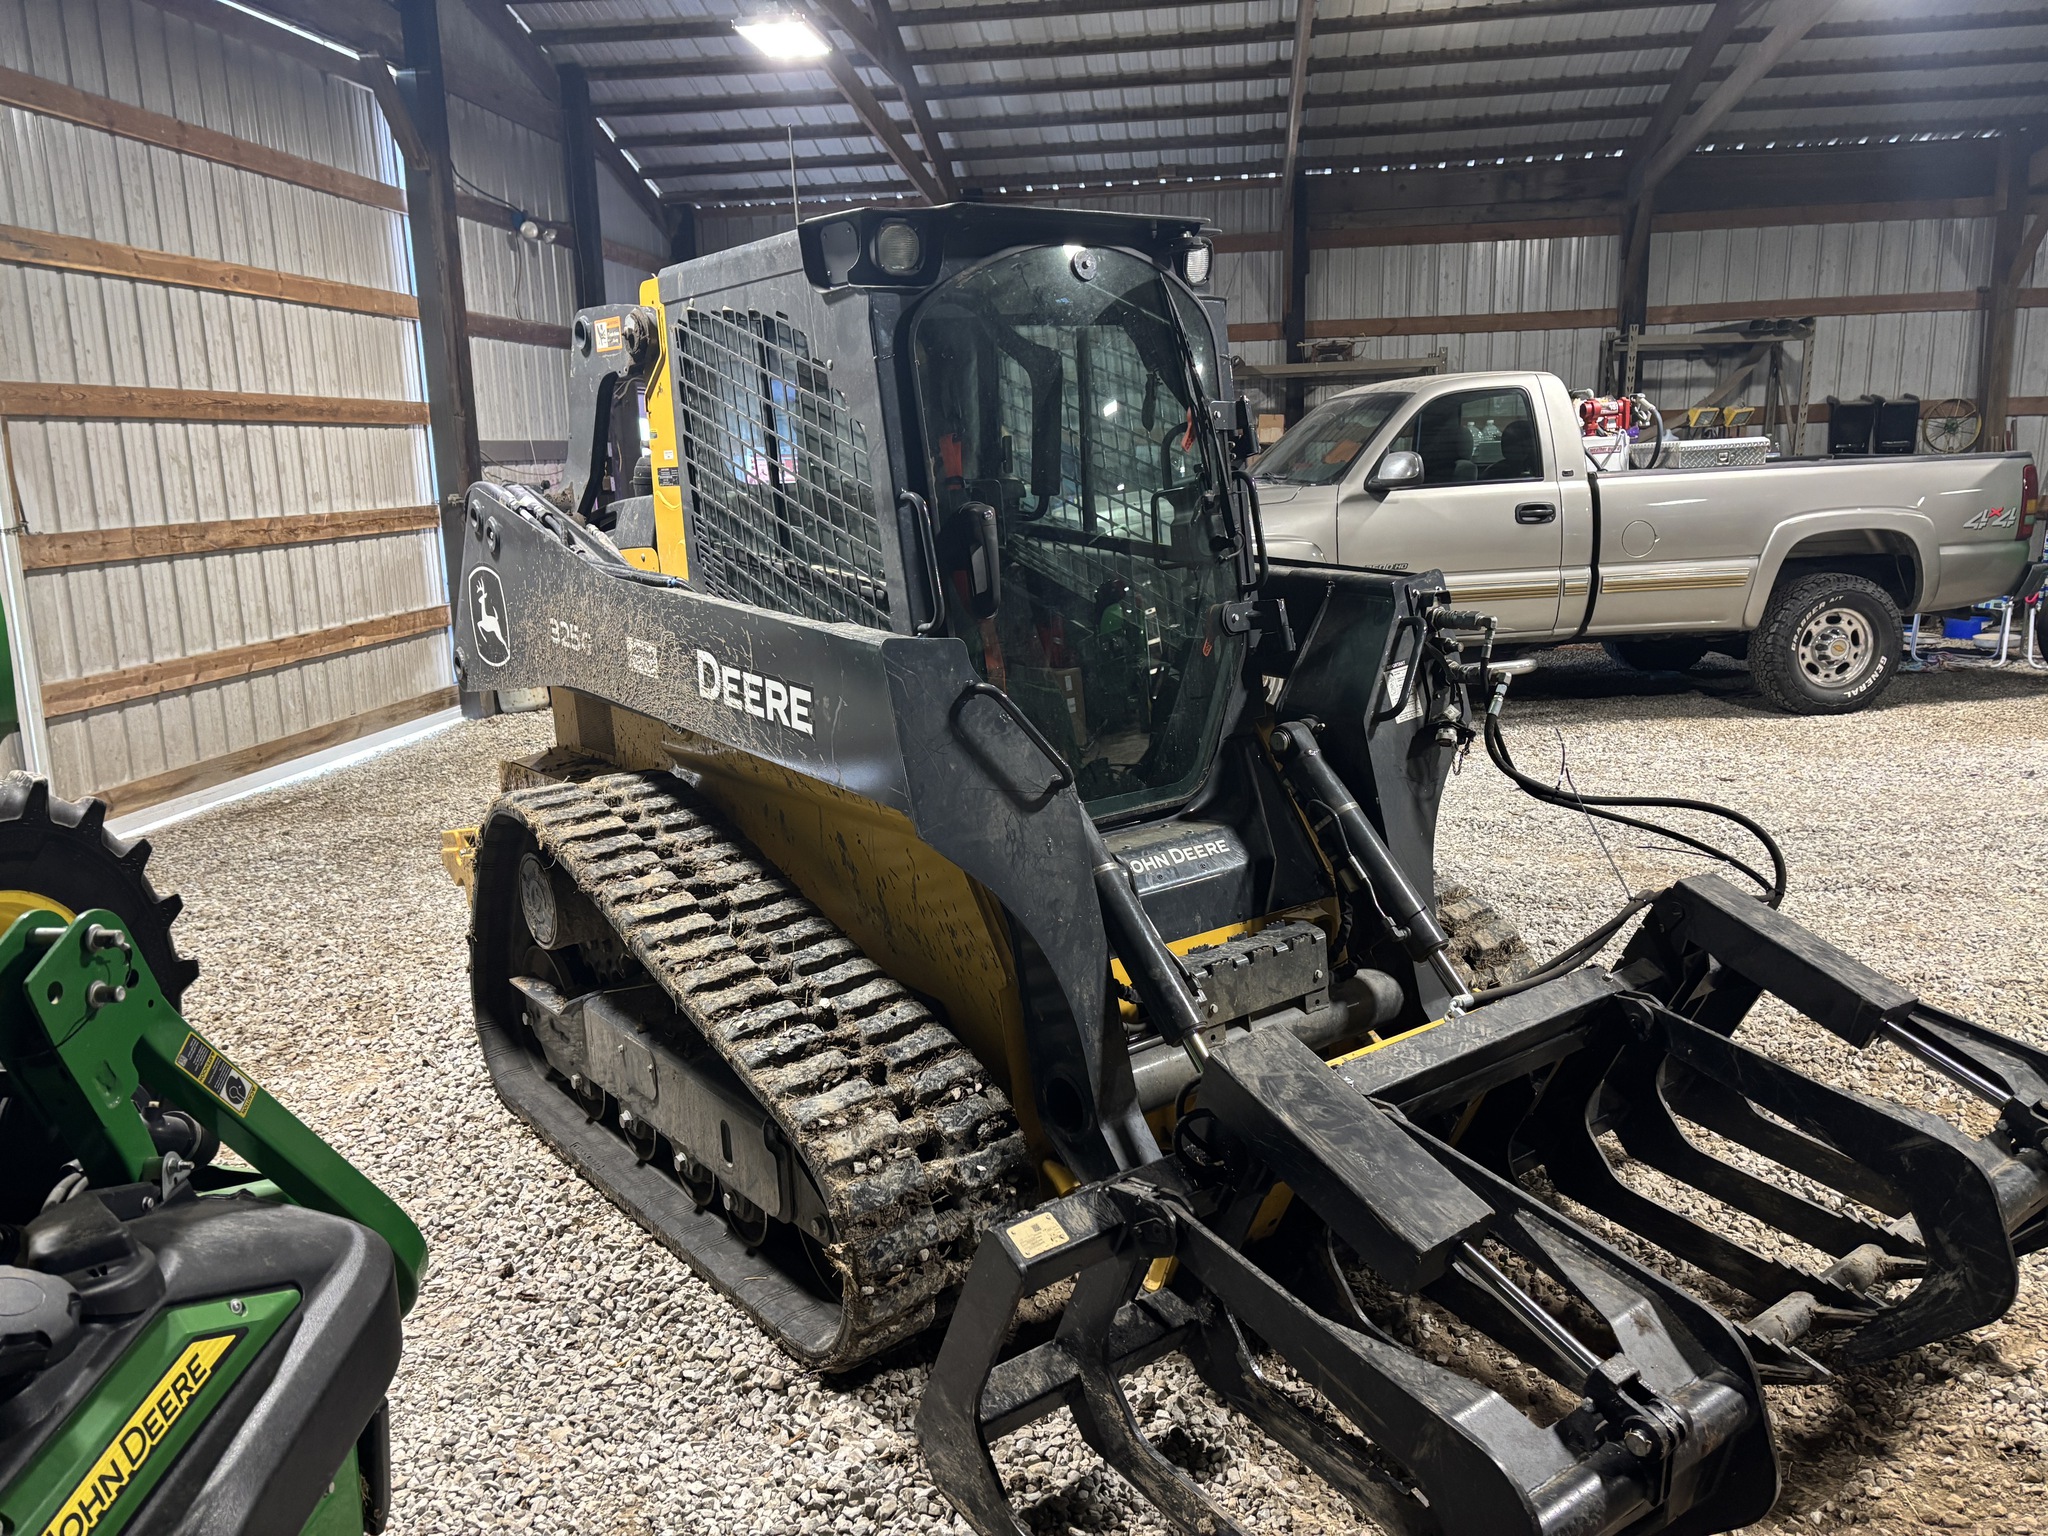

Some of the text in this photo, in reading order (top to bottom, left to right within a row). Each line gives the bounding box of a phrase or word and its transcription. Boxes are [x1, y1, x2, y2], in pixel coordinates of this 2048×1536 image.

[1791, 595, 1844, 651] GRABBER A/T
[696, 648, 814, 735] DEERE
[1843, 655, 1888, 698] GENERAL
[1124, 839, 1230, 876] OHN DEERE
[241, 1089, 255, 1115] CAUTION
[43, 1352, 208, 1536] OHN DEERE
